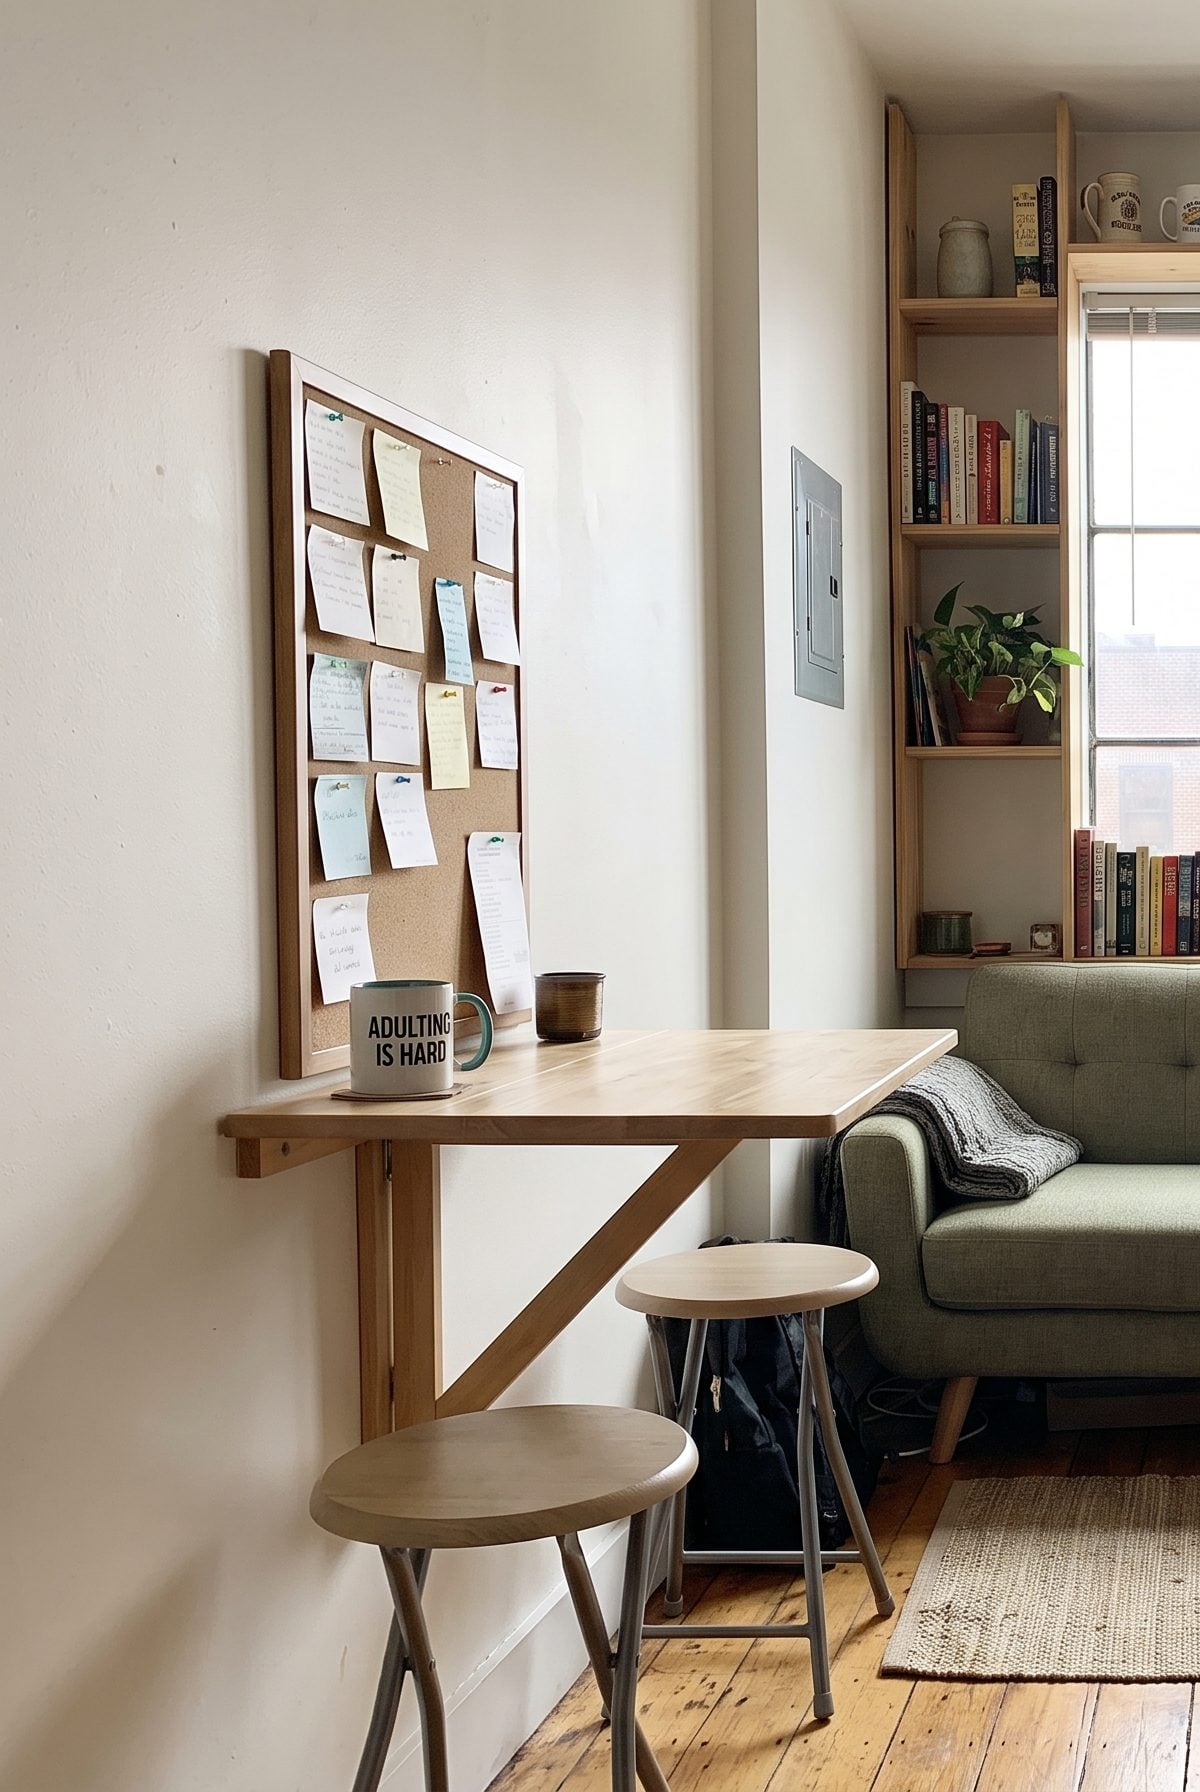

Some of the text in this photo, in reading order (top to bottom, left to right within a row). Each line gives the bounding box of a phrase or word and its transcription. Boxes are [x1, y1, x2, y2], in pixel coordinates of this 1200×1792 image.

[368, 1012, 450, 1038] ADULTING
[376, 1040, 446, 1067] IS HARD
